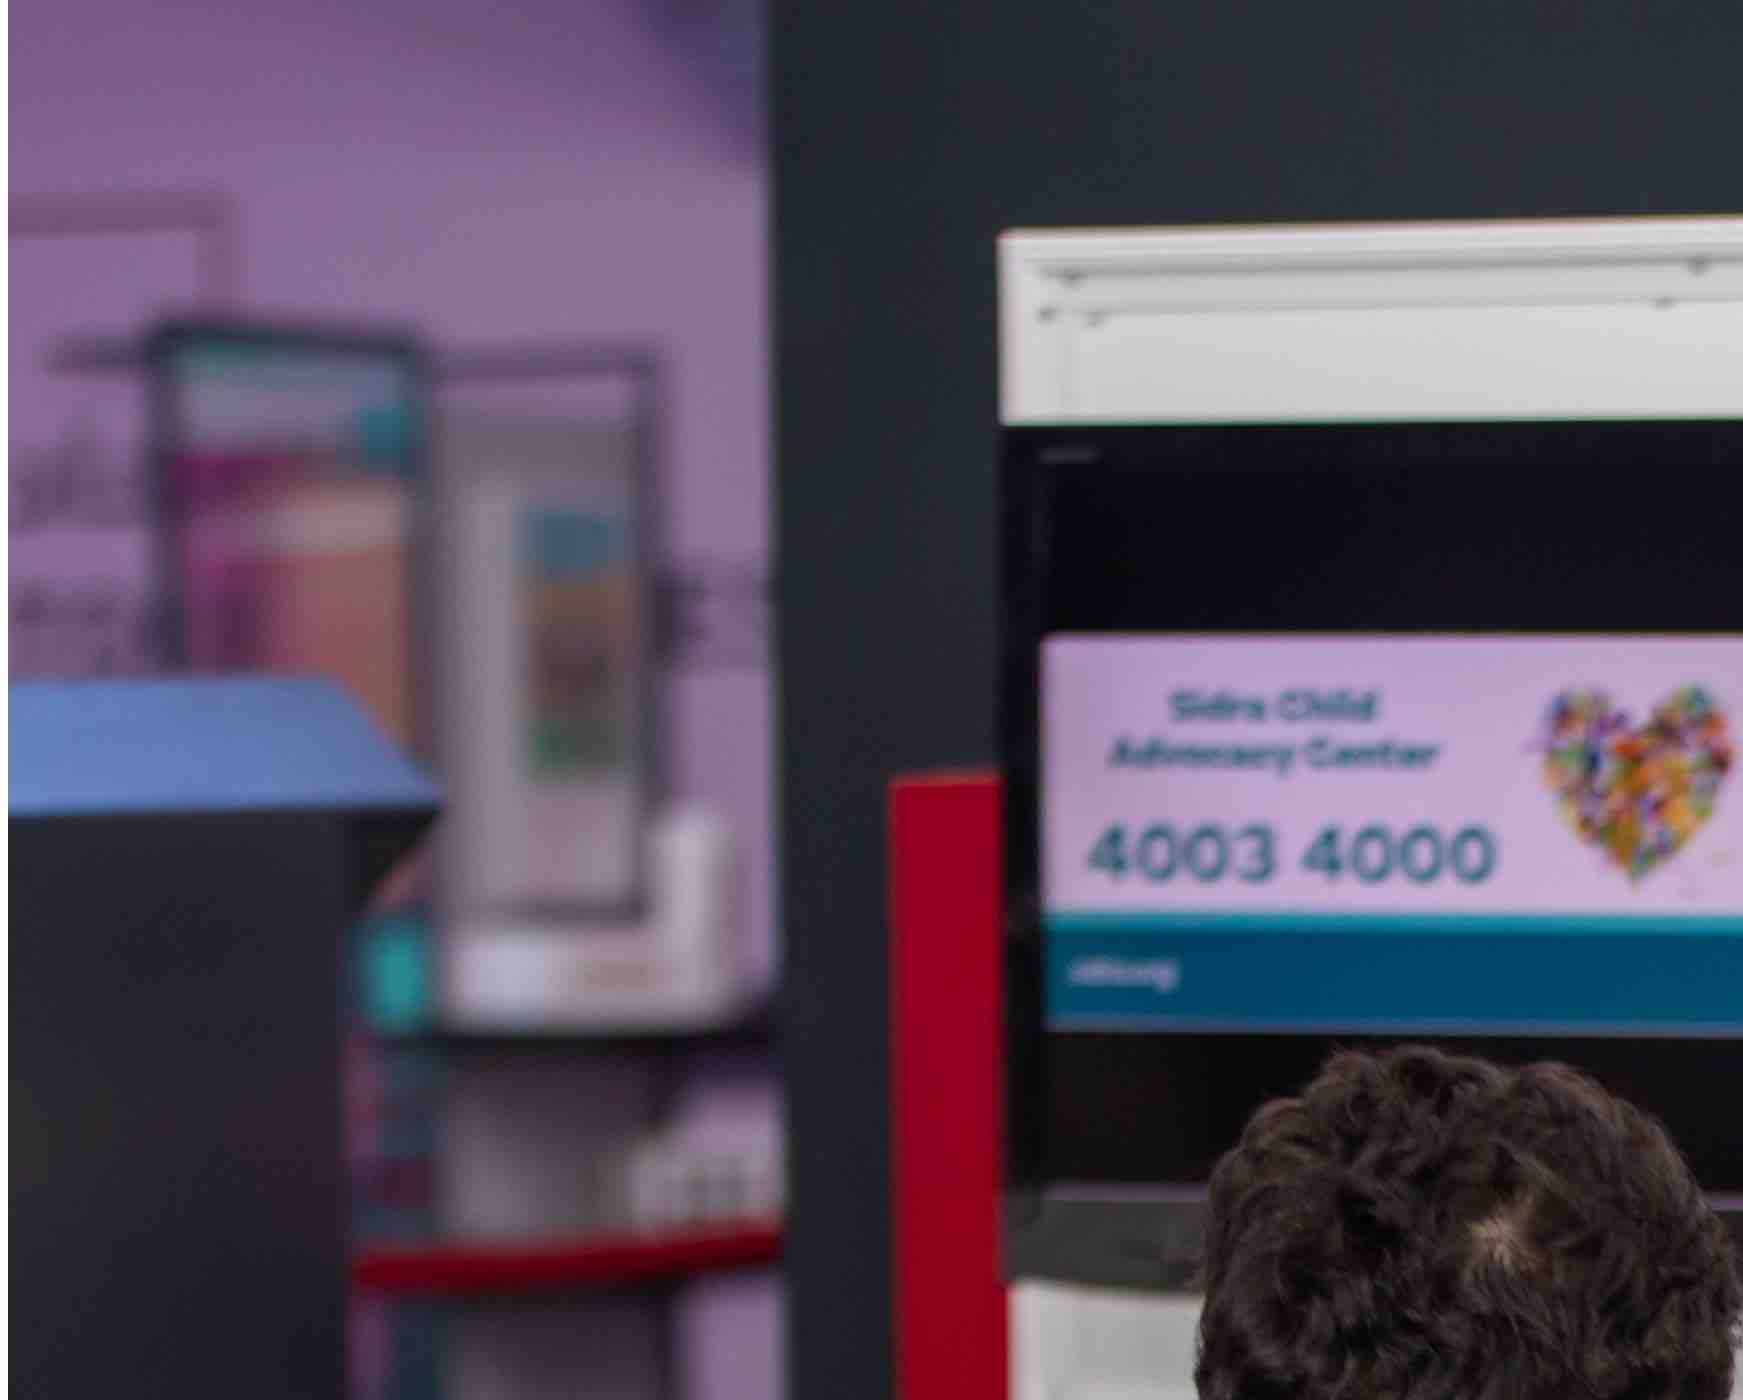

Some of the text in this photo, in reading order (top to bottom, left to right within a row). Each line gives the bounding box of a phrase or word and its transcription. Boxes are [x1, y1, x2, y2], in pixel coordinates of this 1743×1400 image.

[1167, 687, 1380, 723] Sidra Child
[1106, 735, 1441, 778] Advocacy Center
[1086, 822, 1498, 885] 4003 4000
